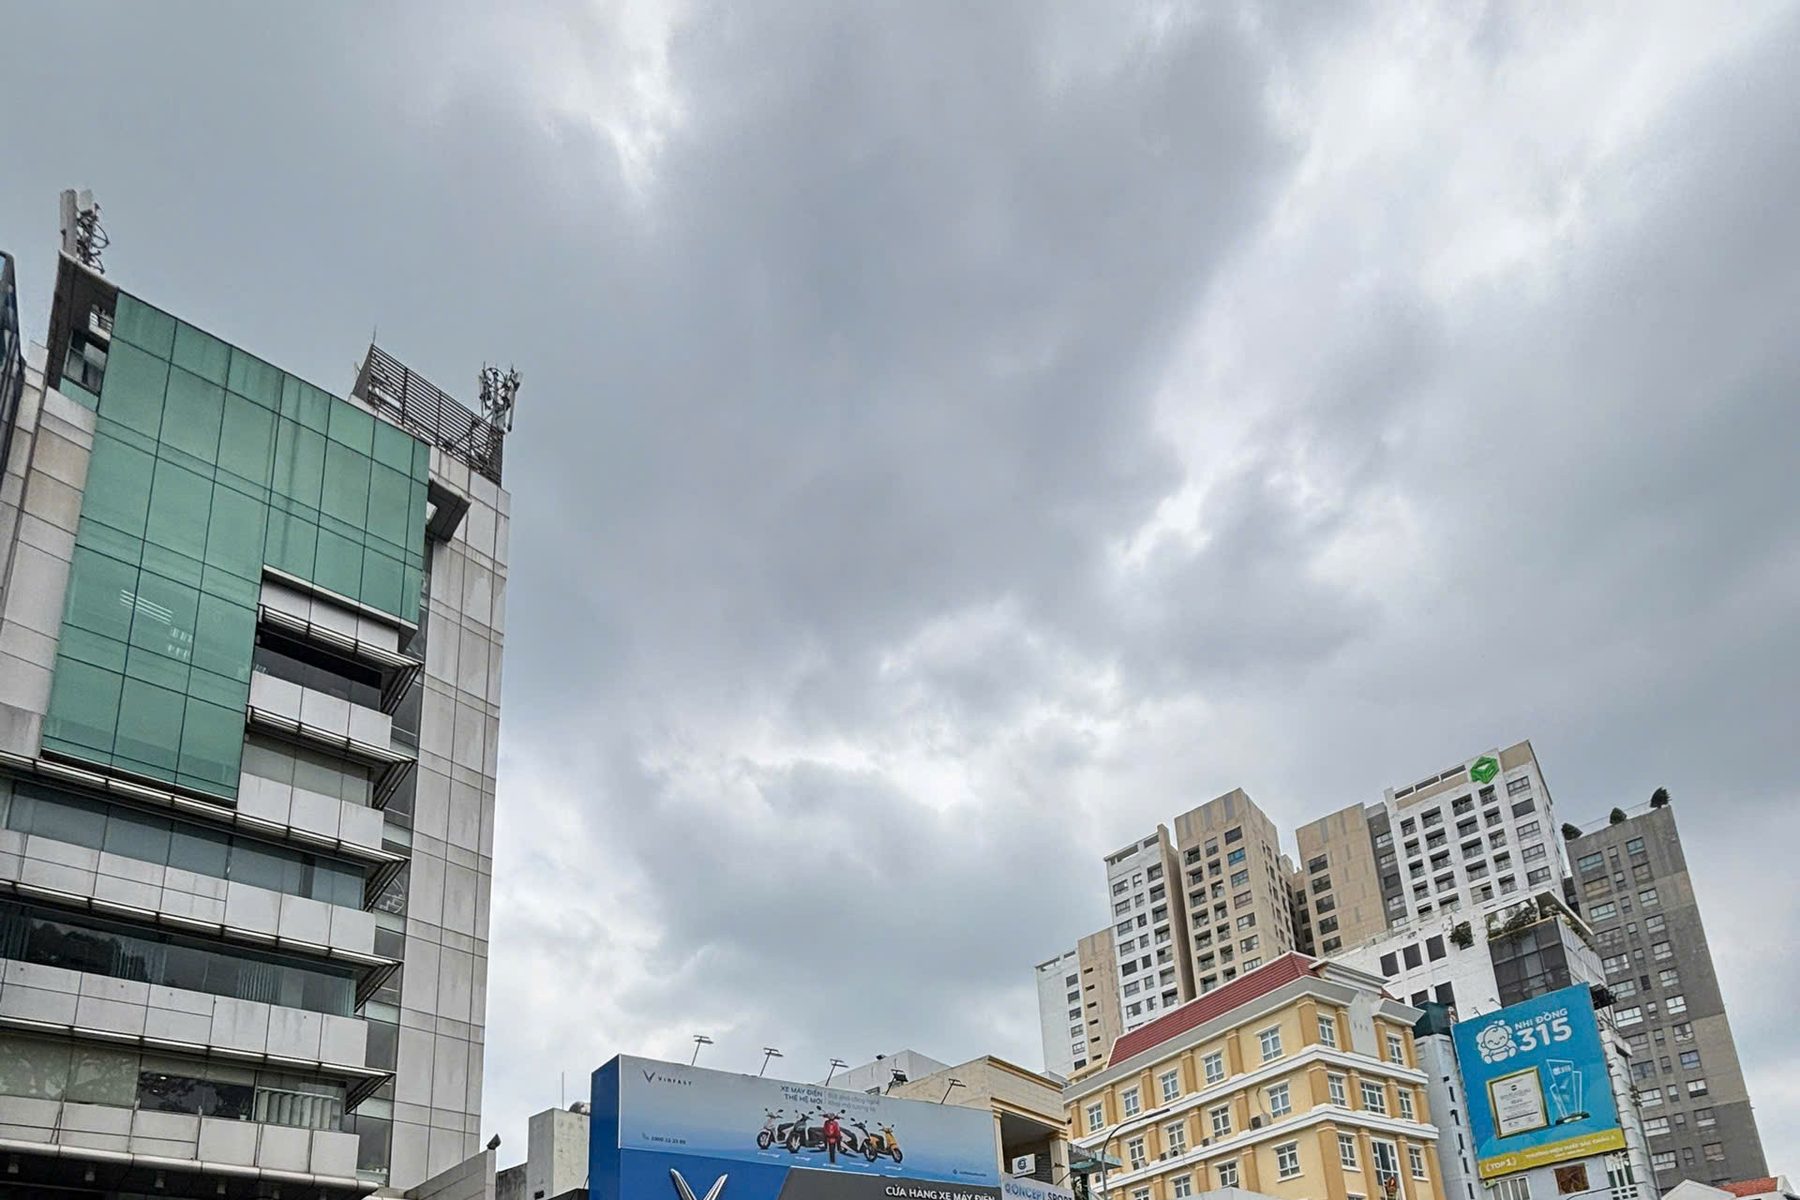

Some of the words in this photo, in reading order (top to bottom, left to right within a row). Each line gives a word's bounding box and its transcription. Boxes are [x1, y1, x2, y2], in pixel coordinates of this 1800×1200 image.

[1514, 1019, 1533, 1030] NHI
[1535, 1007, 1568, 1024] ĐỒNG
[1517, 1016, 1572, 1051] 315
[658, 1076, 692, 1086] VINFAST
[780, 1085, 789, 1093] XE
[885, 1184, 907, 1197] CỬA
[909, 1186, 937, 1200] HÀNG
[938, 1191, 952, 1200] XE
